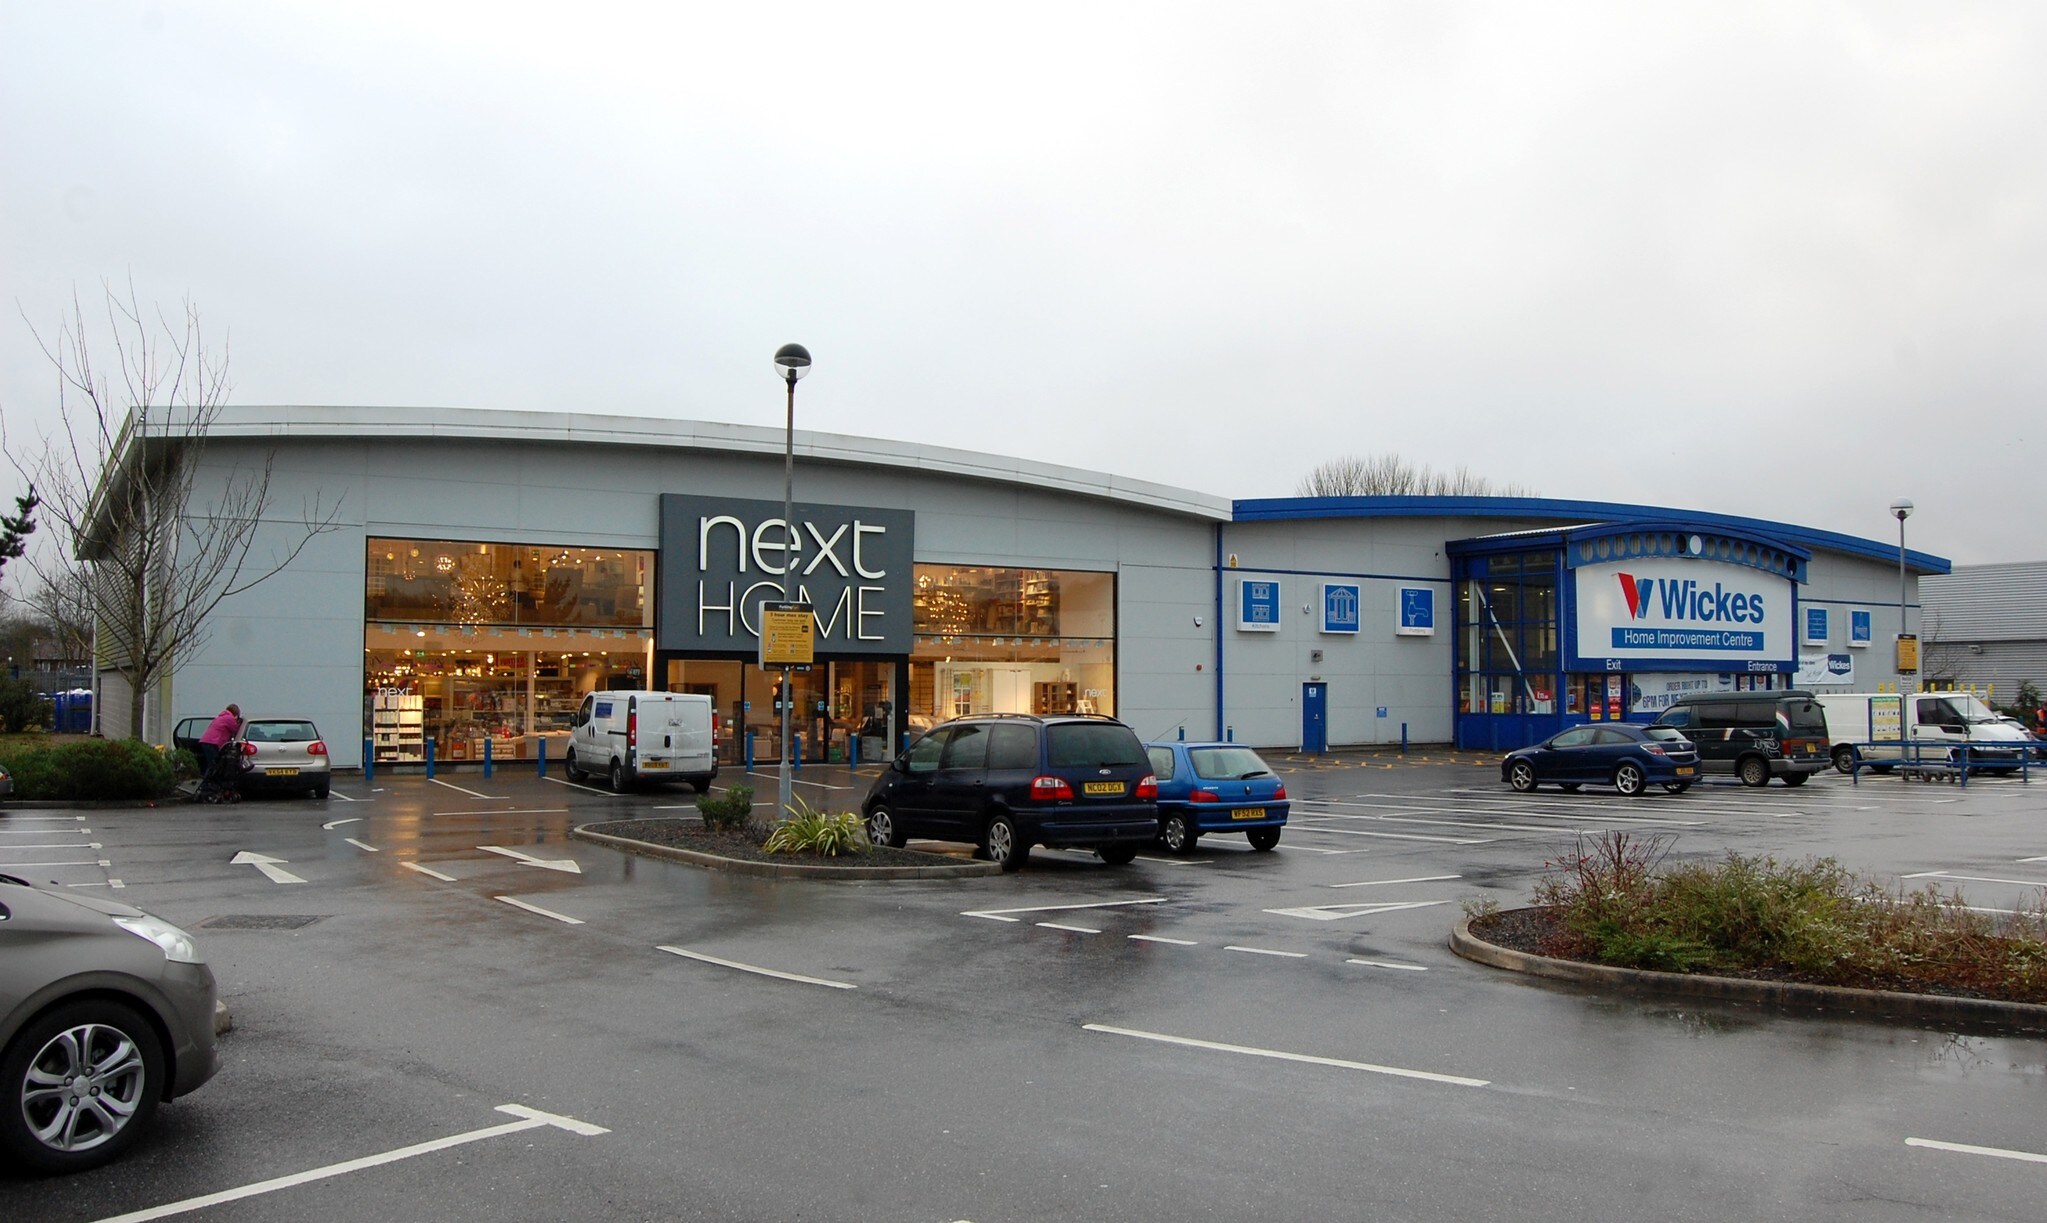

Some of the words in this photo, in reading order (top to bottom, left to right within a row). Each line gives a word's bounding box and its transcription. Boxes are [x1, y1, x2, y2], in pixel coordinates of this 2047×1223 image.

[699, 515, 886, 580] next
[1658, 578, 1764, 624] Wickes
[698, 579, 885, 640] HOME
[1624, 629, 1655, 645] Home
[1657, 630, 1720, 648] Improvement
[1722, 632, 1753, 647] Centre
[1606, 659, 1622, 670] Exit
[1747, 660, 1778, 672] Entrance
[1828, 659, 1850, 671] Wickes
[1666, 681, 1680, 691] ORDER
[1694, 680, 1700, 689] UP
[1701, 679, 1708, 689] TO
[377, 686, 412, 697] next
[1642, 695, 1657, 709] 6PM
[1658, 694, 1670, 708] FOR
[1087, 783, 1107, 792] NC02
[1108, 782, 1122, 792] DGX
